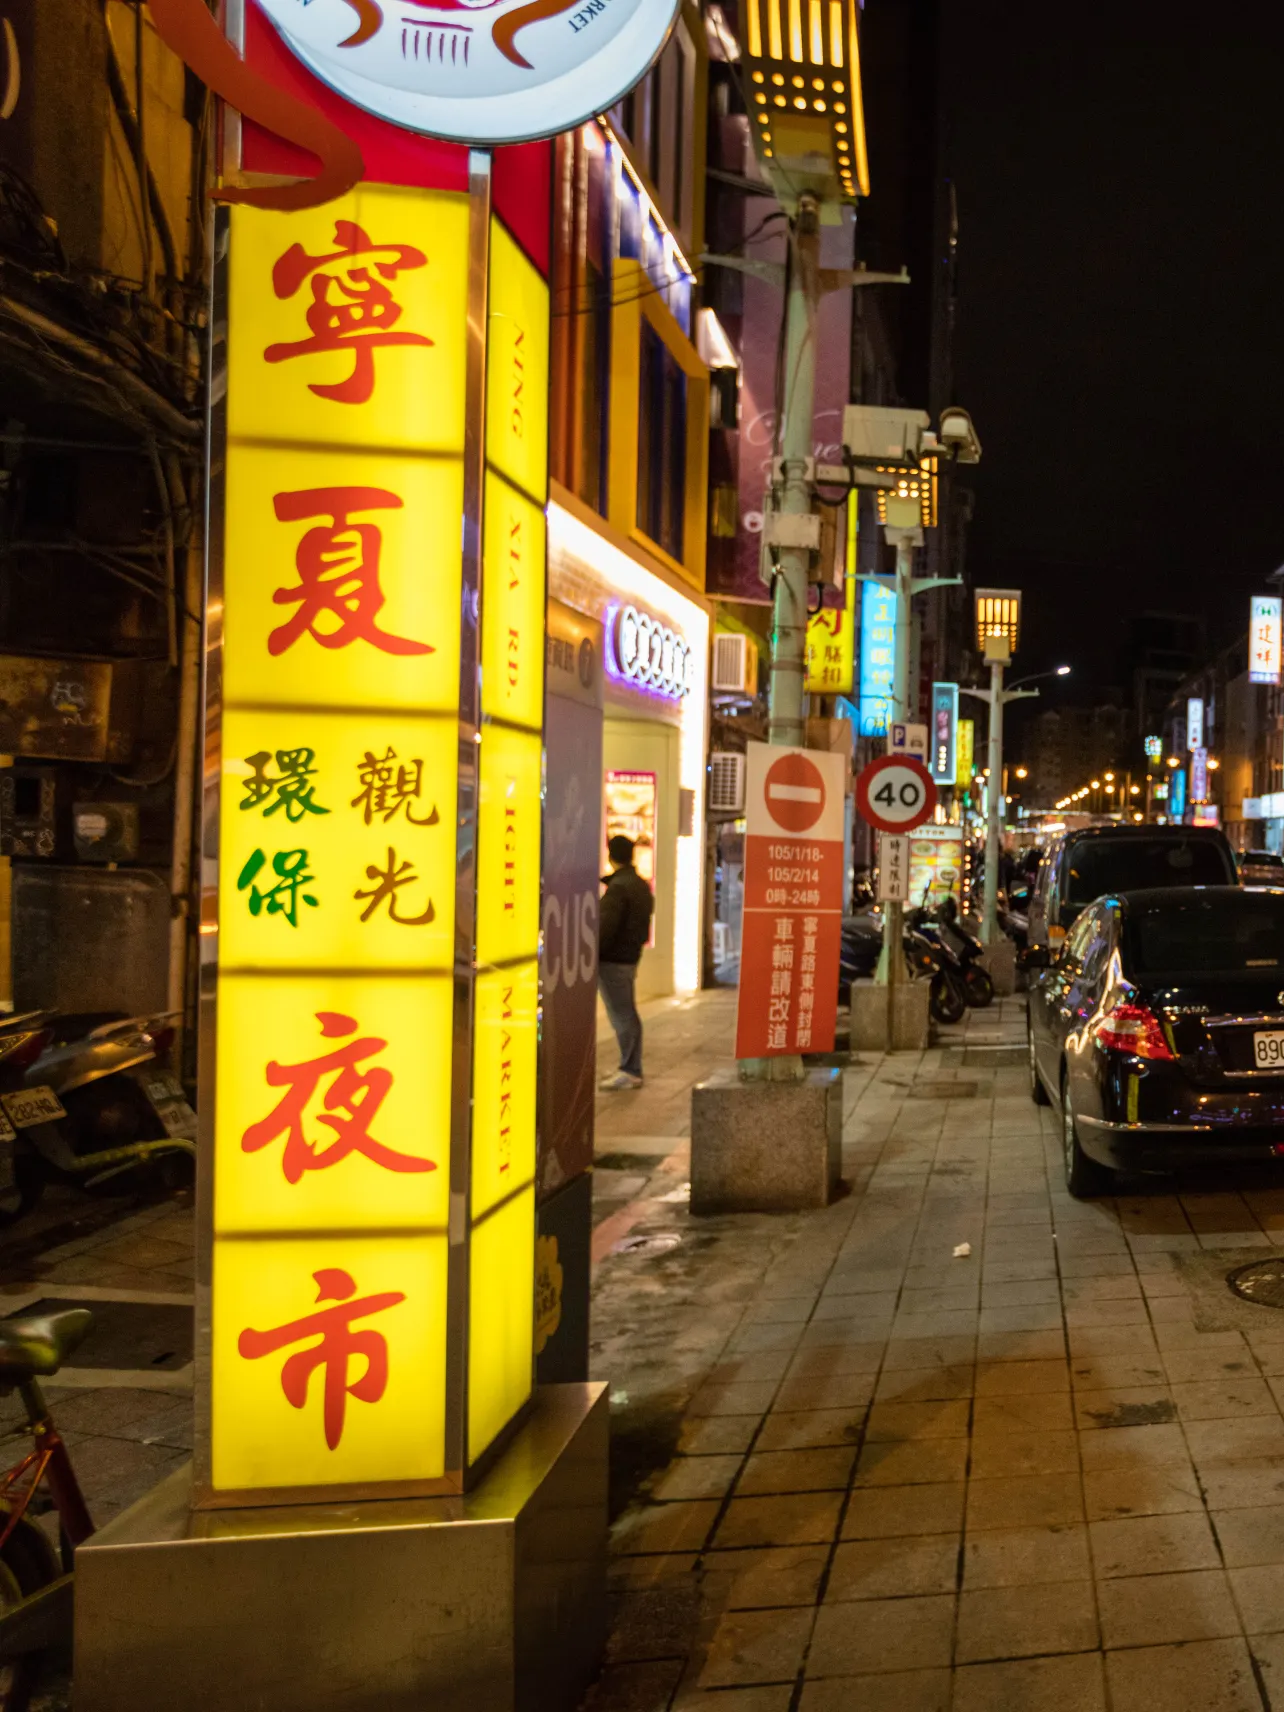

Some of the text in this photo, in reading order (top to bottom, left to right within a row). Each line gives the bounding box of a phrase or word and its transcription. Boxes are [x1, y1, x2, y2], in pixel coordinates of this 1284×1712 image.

[567, 0, 607, 33] RKET
[511, 322, 525, 440] NING
[508, 514, 522, 592] XIA
[894, 726, 906, 747] P
[874, 782, 920, 808] 40
[237, 746, 332, 928] 環保
[350, 746, 440, 926] 觀光
[766, 889, 821, 906] 0時-24時
[767, 868, 820, 883] 105/2/14
[767, 917, 795, 1049] 車輛請改道
